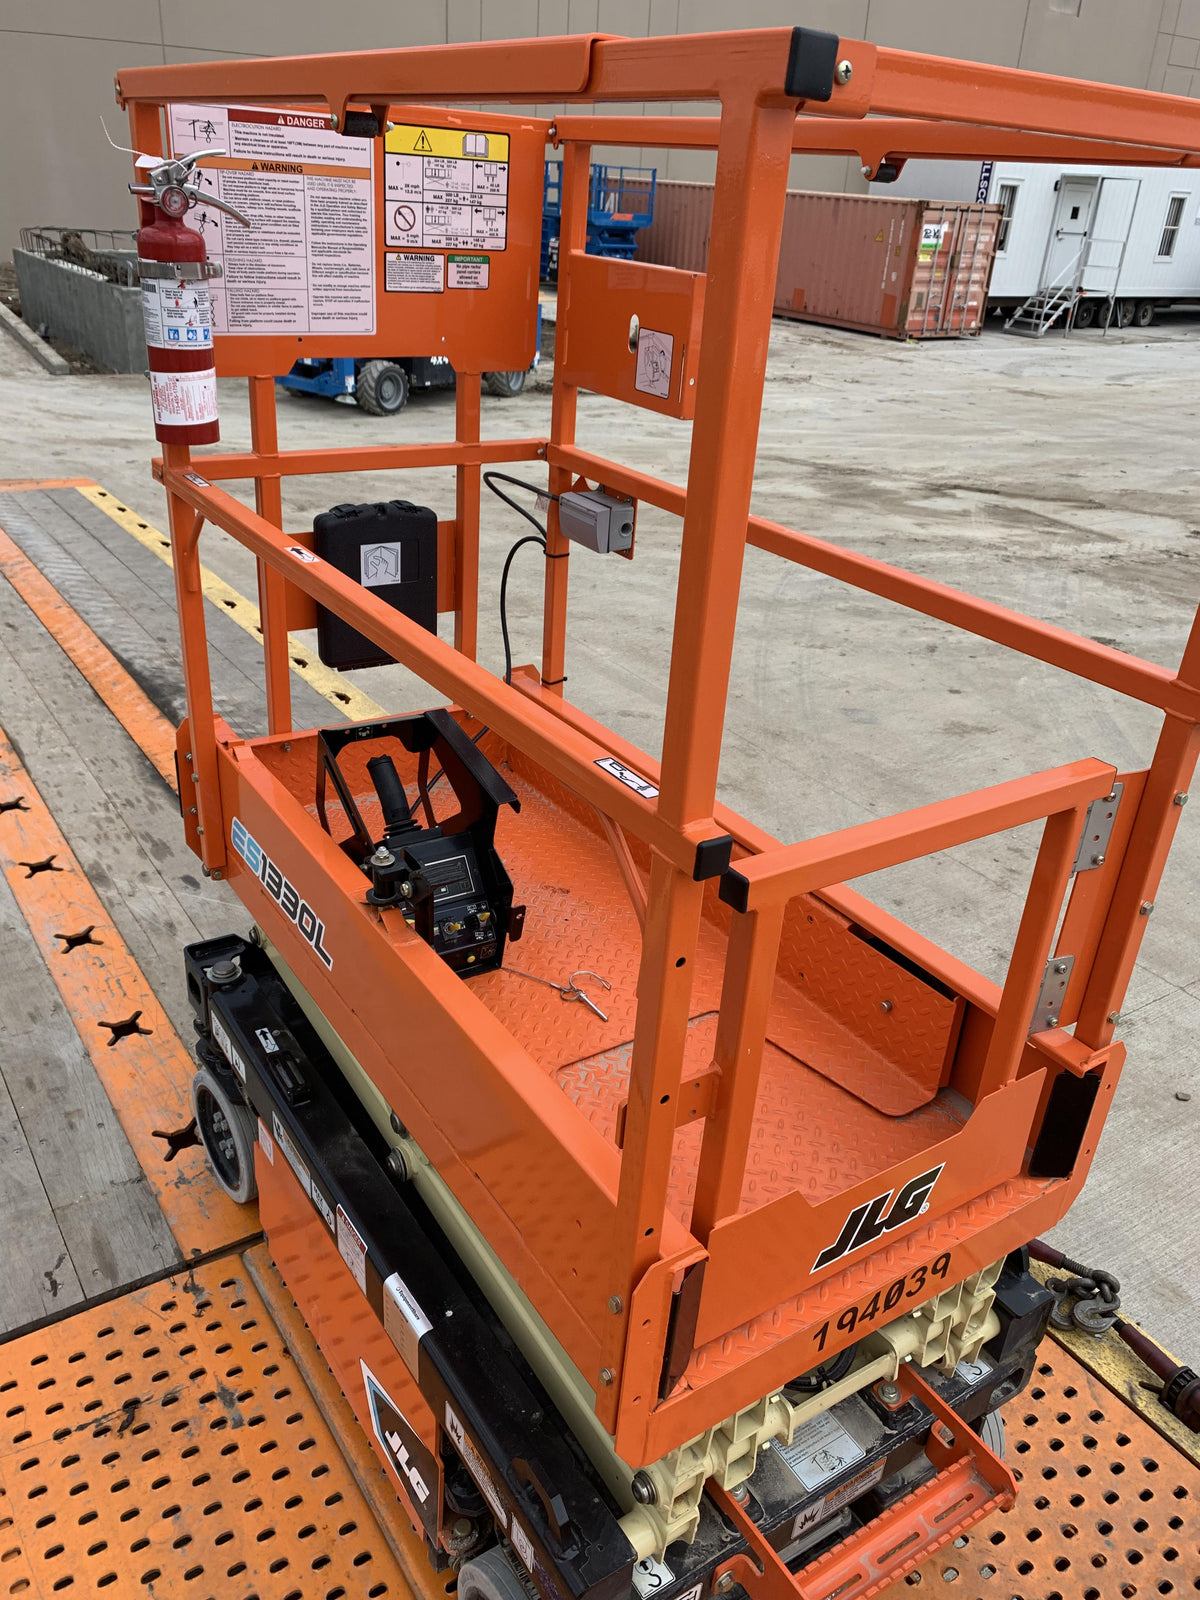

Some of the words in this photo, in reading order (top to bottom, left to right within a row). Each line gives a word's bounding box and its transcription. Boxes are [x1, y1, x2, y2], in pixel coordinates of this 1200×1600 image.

[286, 116, 325, 129] DANGER
[260, 162, 303, 173] WARNING
[231, 816, 333, 971] ES1330L
[809, 1162, 946, 1275] JLG
[813, 1252, 951, 1352] 194039
[384, 1430, 430, 1504] JLG
